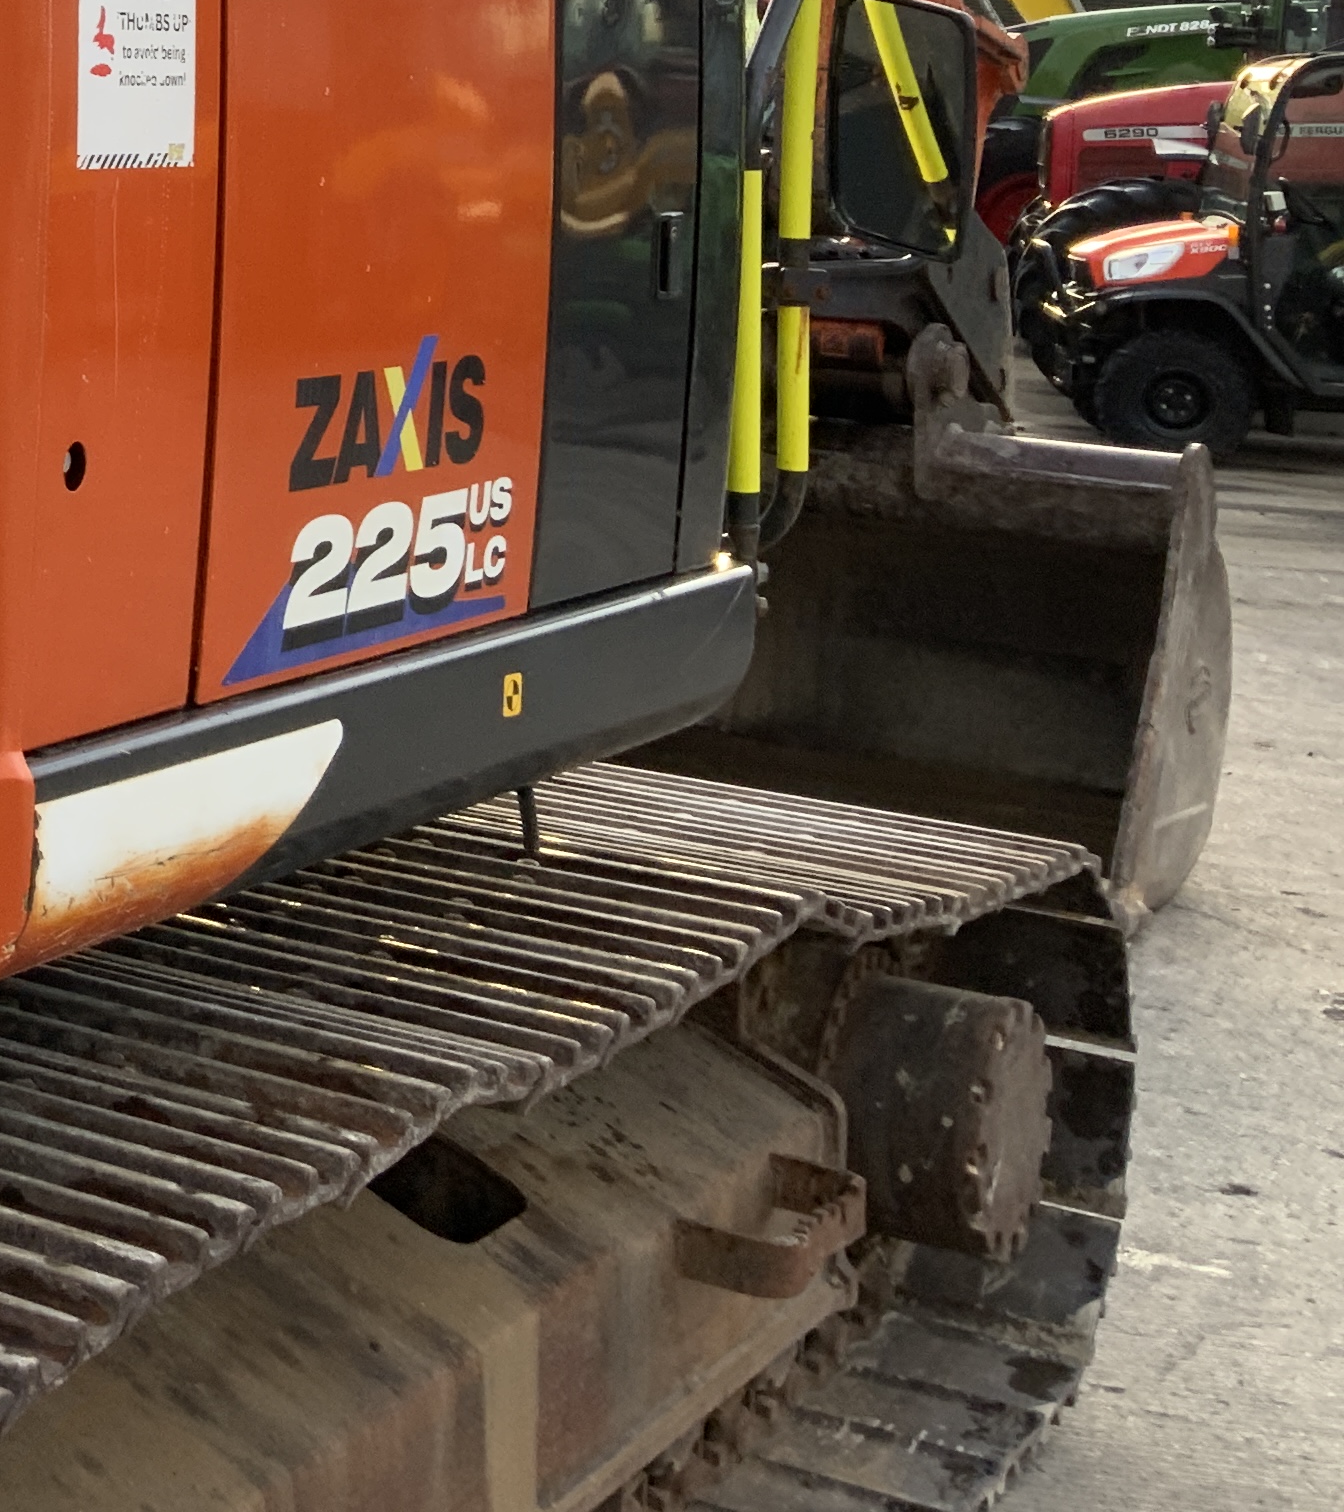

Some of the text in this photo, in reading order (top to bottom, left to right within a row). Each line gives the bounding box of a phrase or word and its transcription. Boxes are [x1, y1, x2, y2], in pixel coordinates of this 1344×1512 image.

[173, 13, 189, 32] UP
[1126, 19, 1210, 37] FNDT 828
[122, 45, 132, 59] to
[161, 44, 186, 64] being
[1104, 127, 1159, 139] 6290
[288, 334, 486, 493] ZAXIS
[282, 476, 513, 643] 225 US
[463, 535, 507, 588] LC
